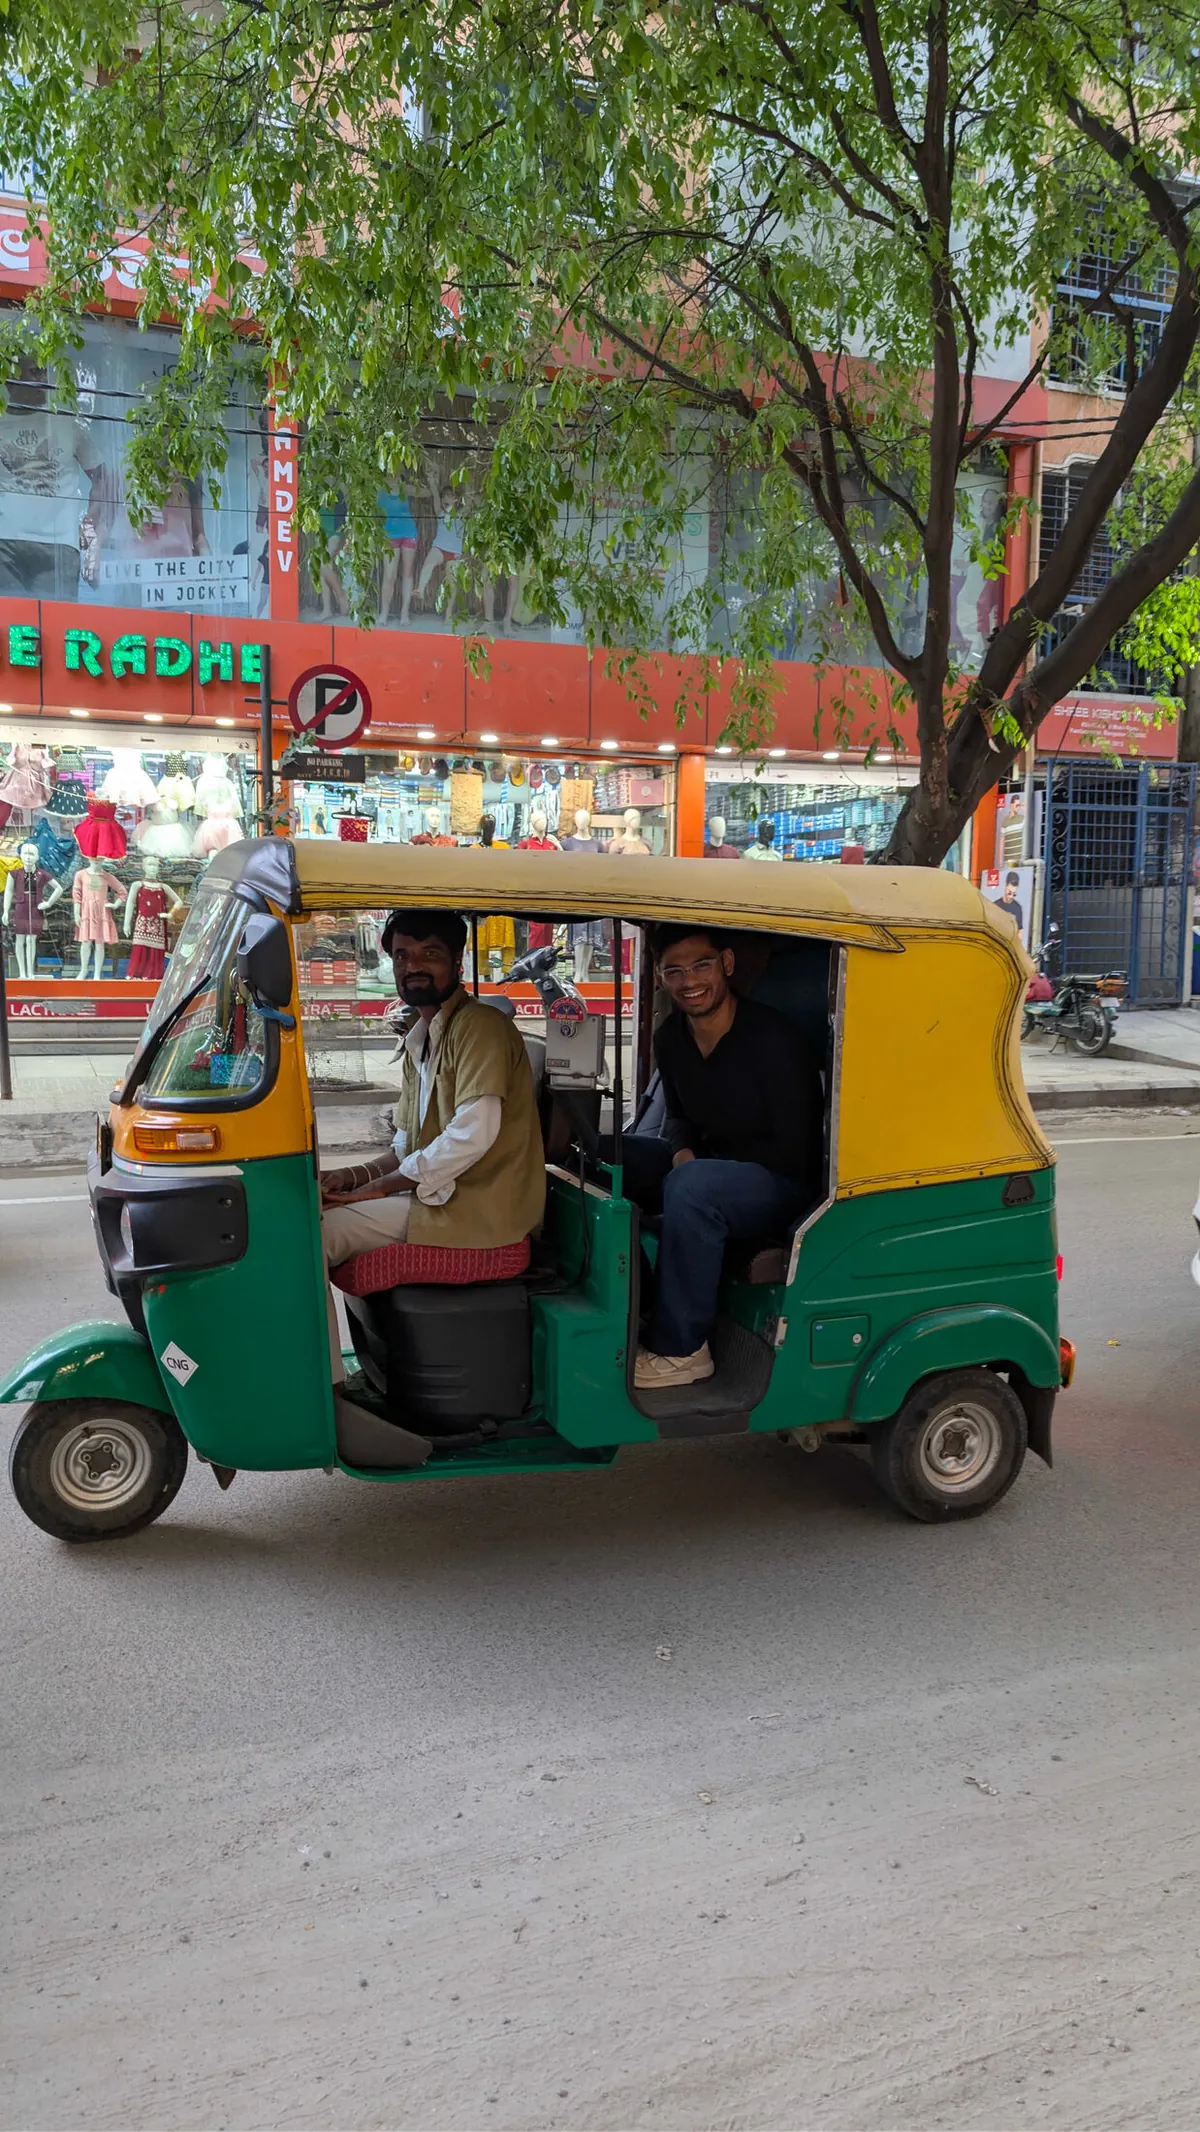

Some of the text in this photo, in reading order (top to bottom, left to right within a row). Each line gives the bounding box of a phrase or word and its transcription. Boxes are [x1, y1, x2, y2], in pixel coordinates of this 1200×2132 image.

[105, 560, 235, 579] LIVE THE CITY
[147, 585, 237, 602] IN JOCKEY
[64, 629, 262, 685] RADHE
[316, 757, 344, 767] PARKING
[166, 1357, 189, 1371] CNG
